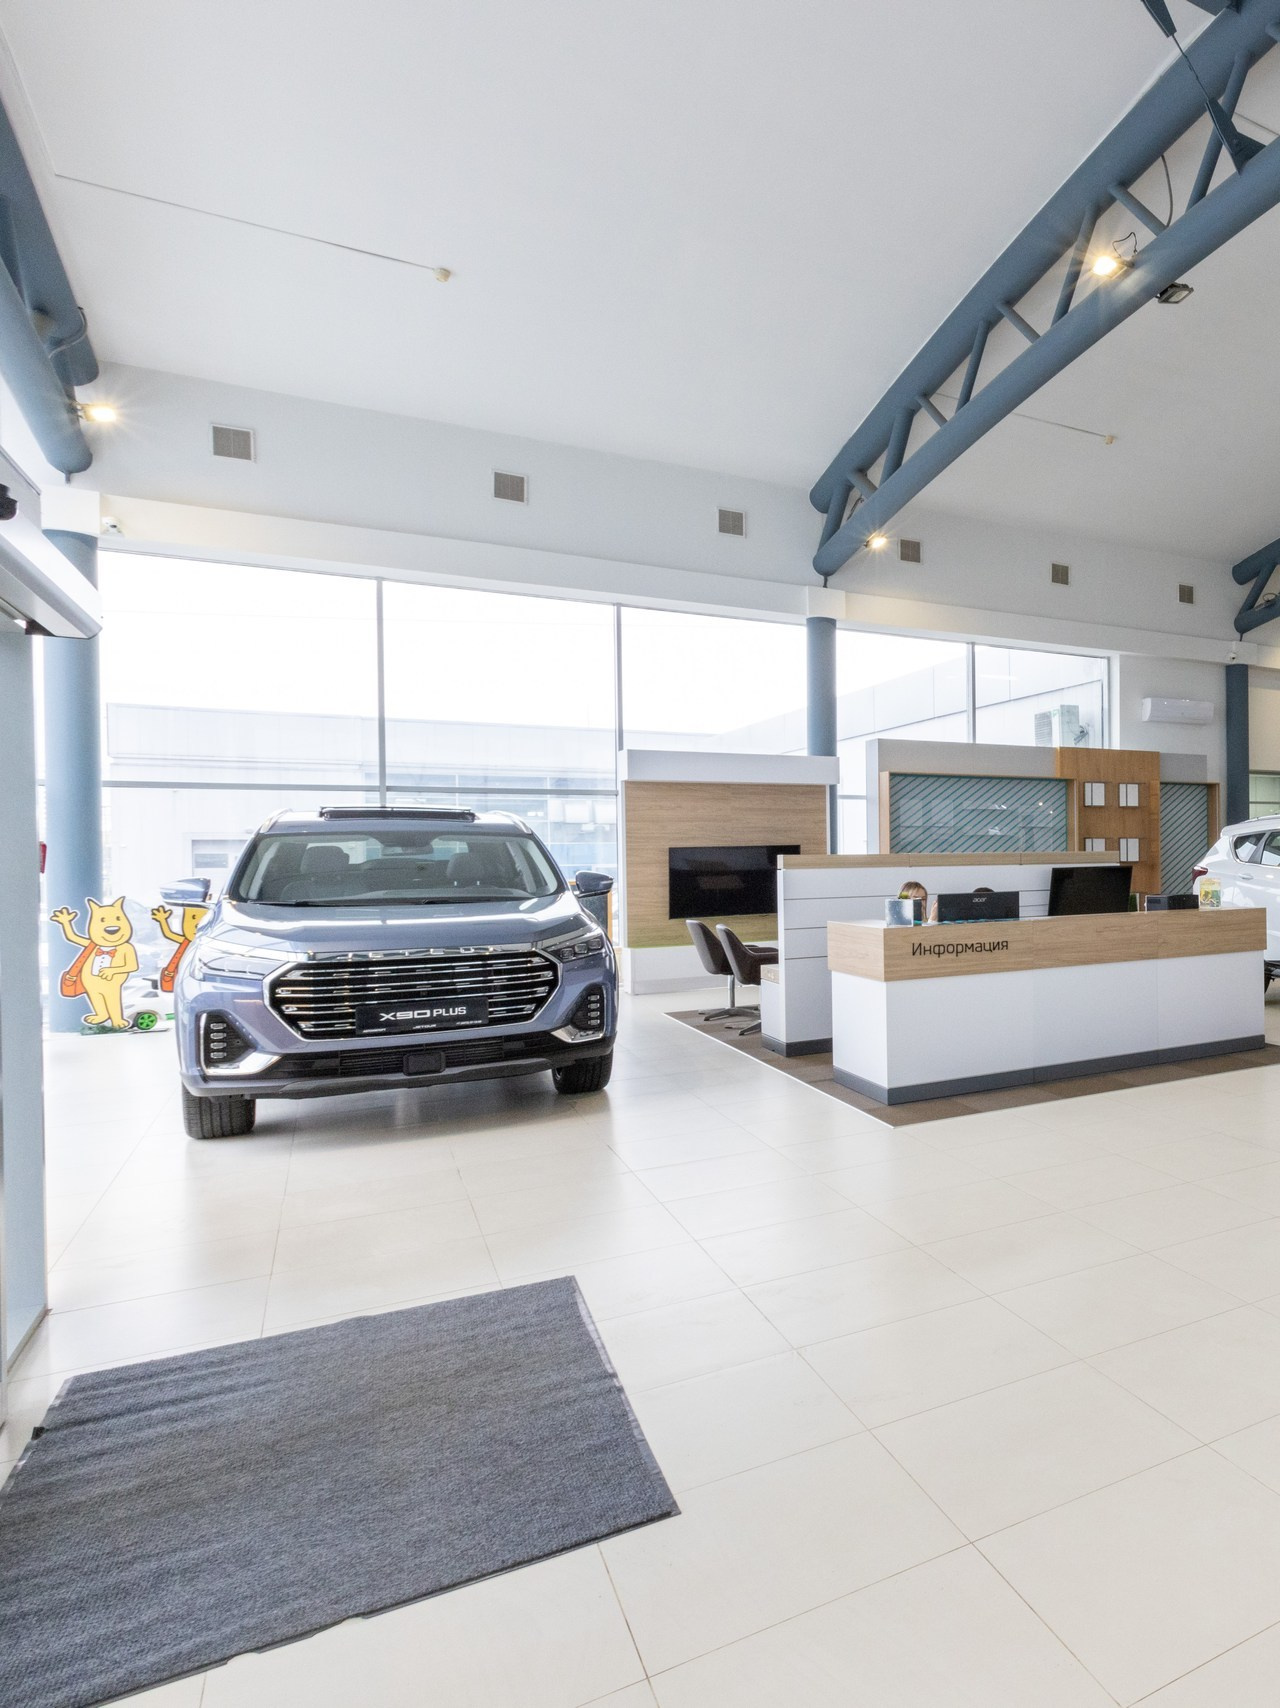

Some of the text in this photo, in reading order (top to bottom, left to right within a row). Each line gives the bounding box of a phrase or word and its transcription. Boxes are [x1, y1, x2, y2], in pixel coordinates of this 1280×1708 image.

[912, 940, 1009, 958] Информация
[379, 1006, 467, 1022] X90 PLUS
